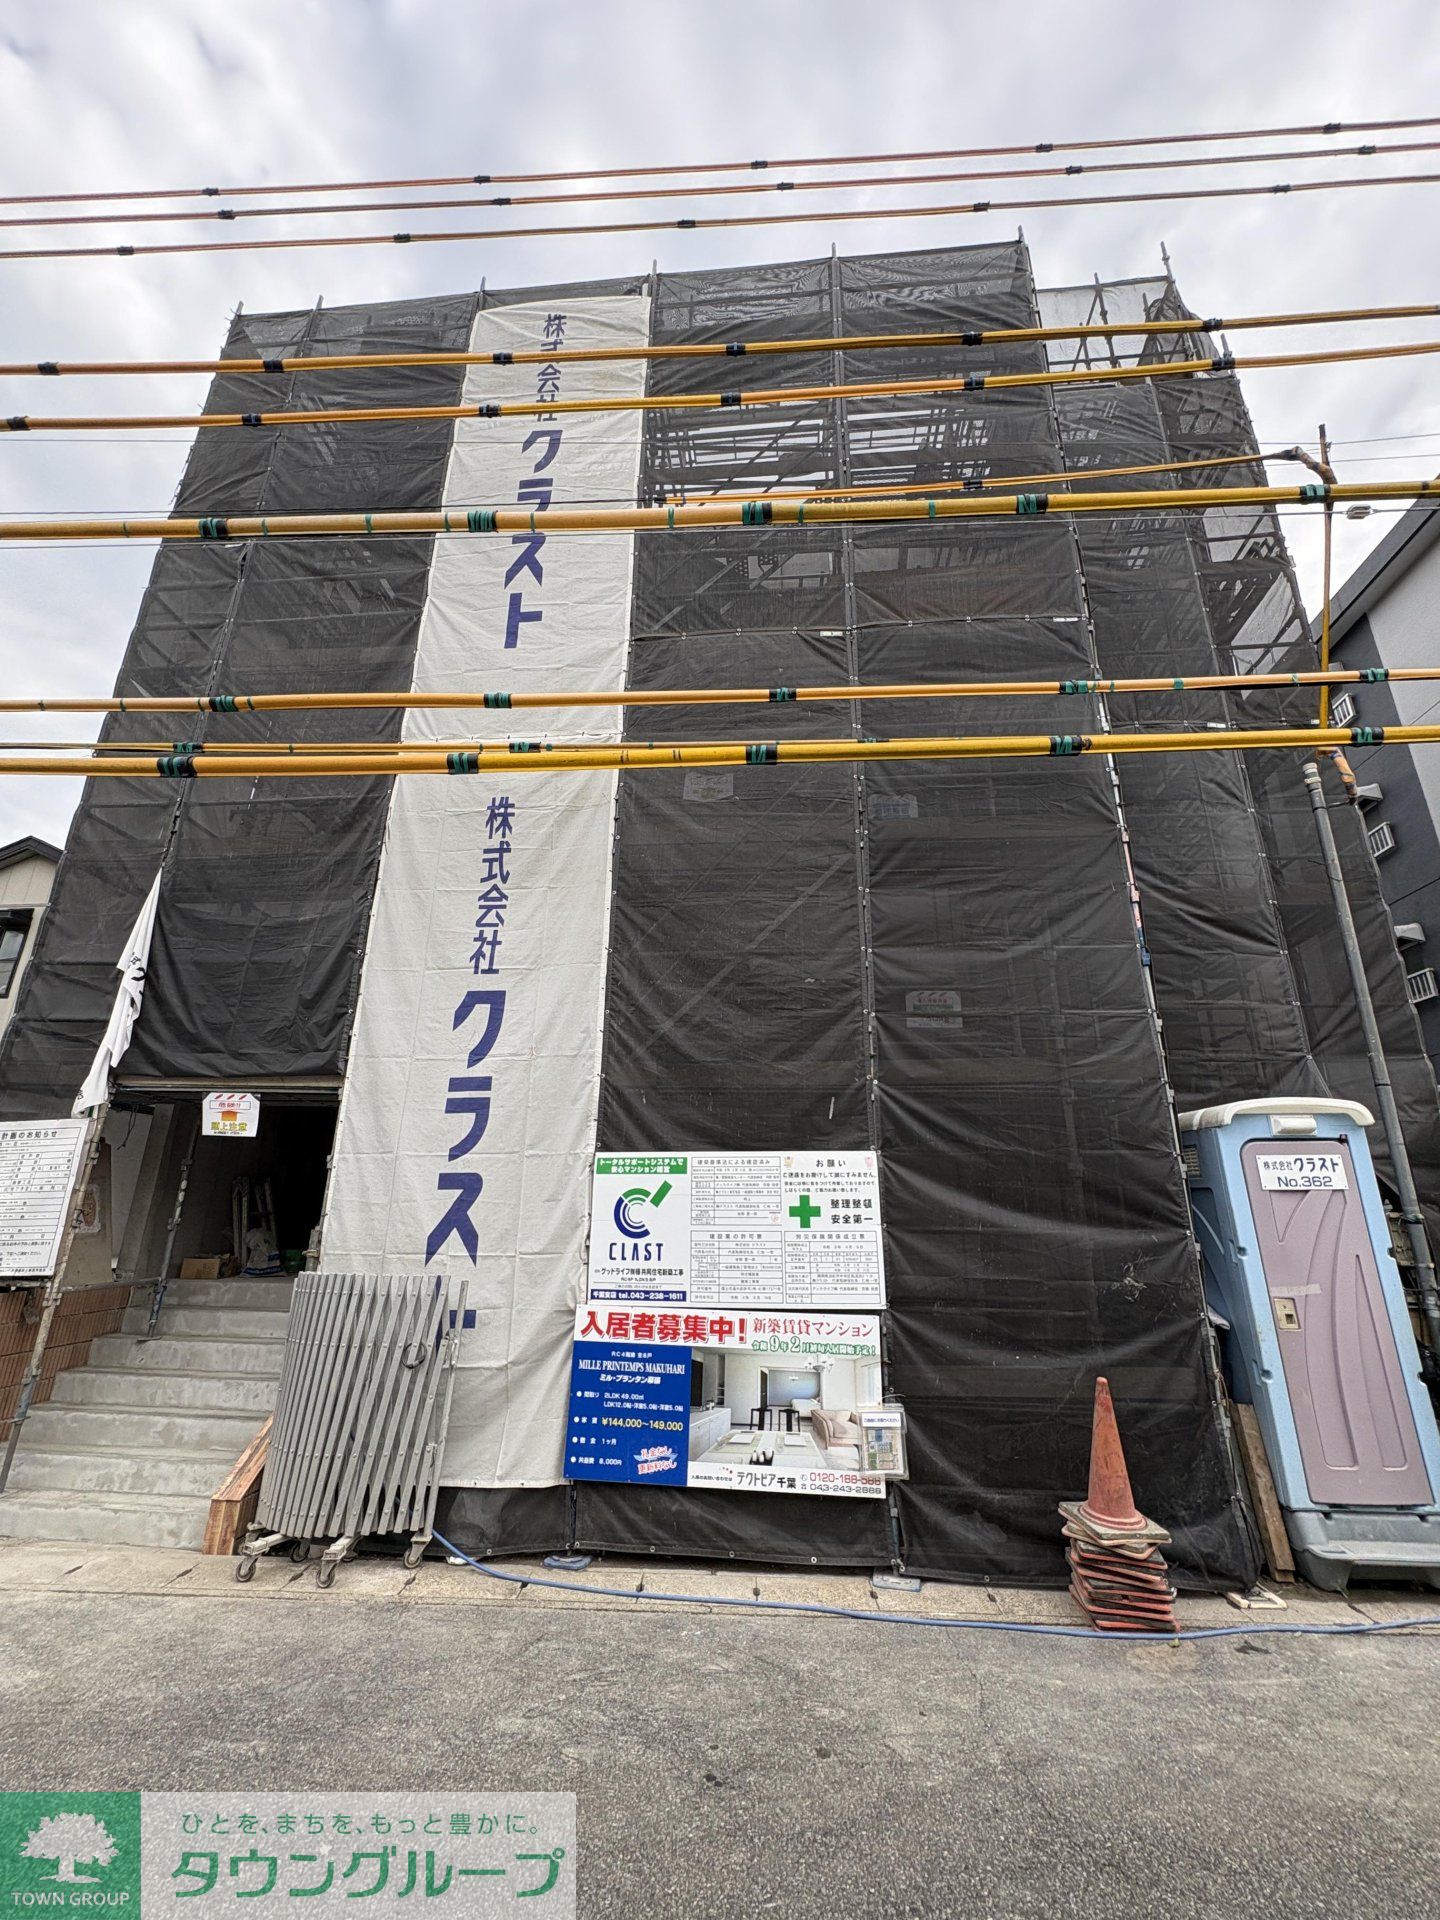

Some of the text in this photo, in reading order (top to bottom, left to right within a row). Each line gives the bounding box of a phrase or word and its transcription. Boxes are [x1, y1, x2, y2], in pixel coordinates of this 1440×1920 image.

[816, 1159, 846, 1168] お願い
[1263, 1158, 1339, 1173] 株式会社クラスト
[1277, 1176, 1333, 1187] No.362
[830, 1199, 872, 1208] 整理整頓
[831, 1214, 873, 1224] 安全第一
[609, 1243, 663, 1261] CLAST
[753, 1317, 874, 1337] 新築賃貸マンション
[579, 1360, 685, 1374] MILLE PRINTEMPS MAKUHARI
